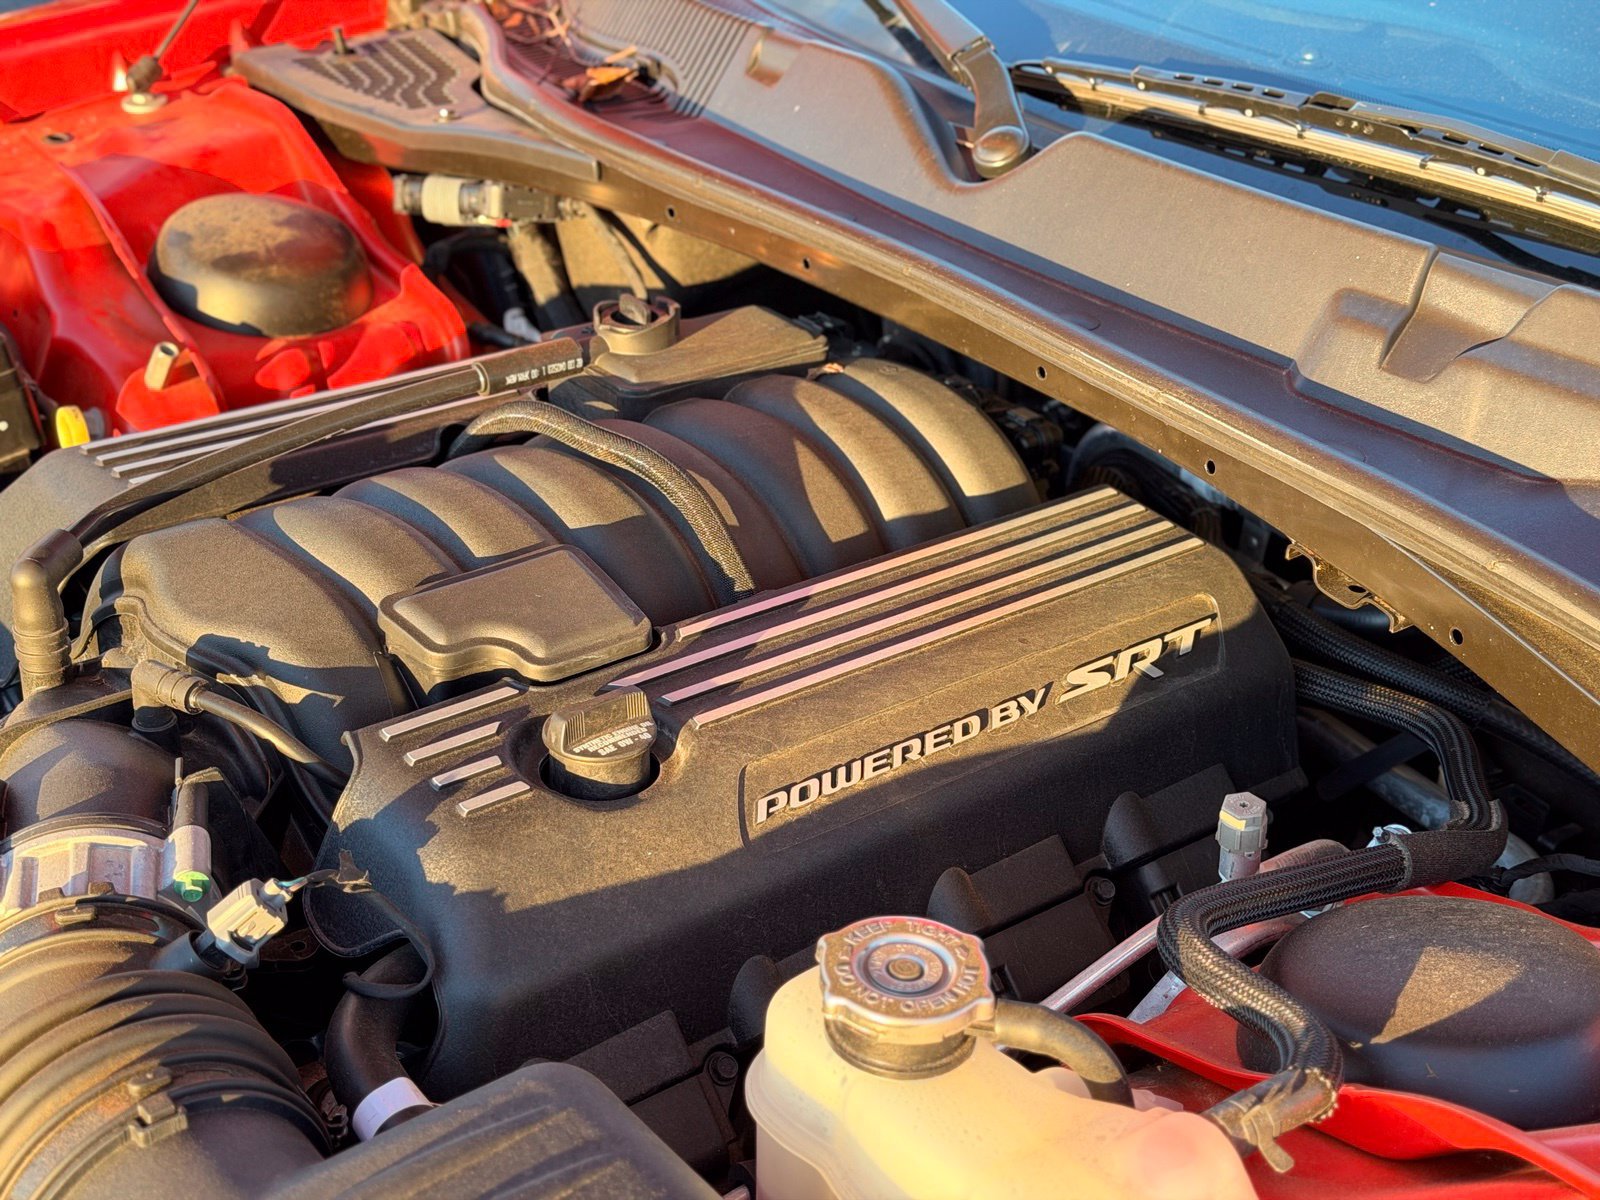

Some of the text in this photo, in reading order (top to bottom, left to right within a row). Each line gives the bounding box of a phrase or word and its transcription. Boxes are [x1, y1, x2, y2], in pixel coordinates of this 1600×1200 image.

[754, 613, 1218, 825] POWERED BY SRT
[573, 732, 613, 753] SYNTHETIC
[611, 724, 641, 741] ENGINE
[588, 727, 648, 753] RECOMMENDED
[597, 746, 618, 756] SAE
[844, 921, 961, 945] KEEP TIGHT
[834, 961, 857, 987] DO
[852, 986, 895, 1010] NOT
[899, 990, 958, 1013] OPEN
[952, 964, 981, 997] HOT
